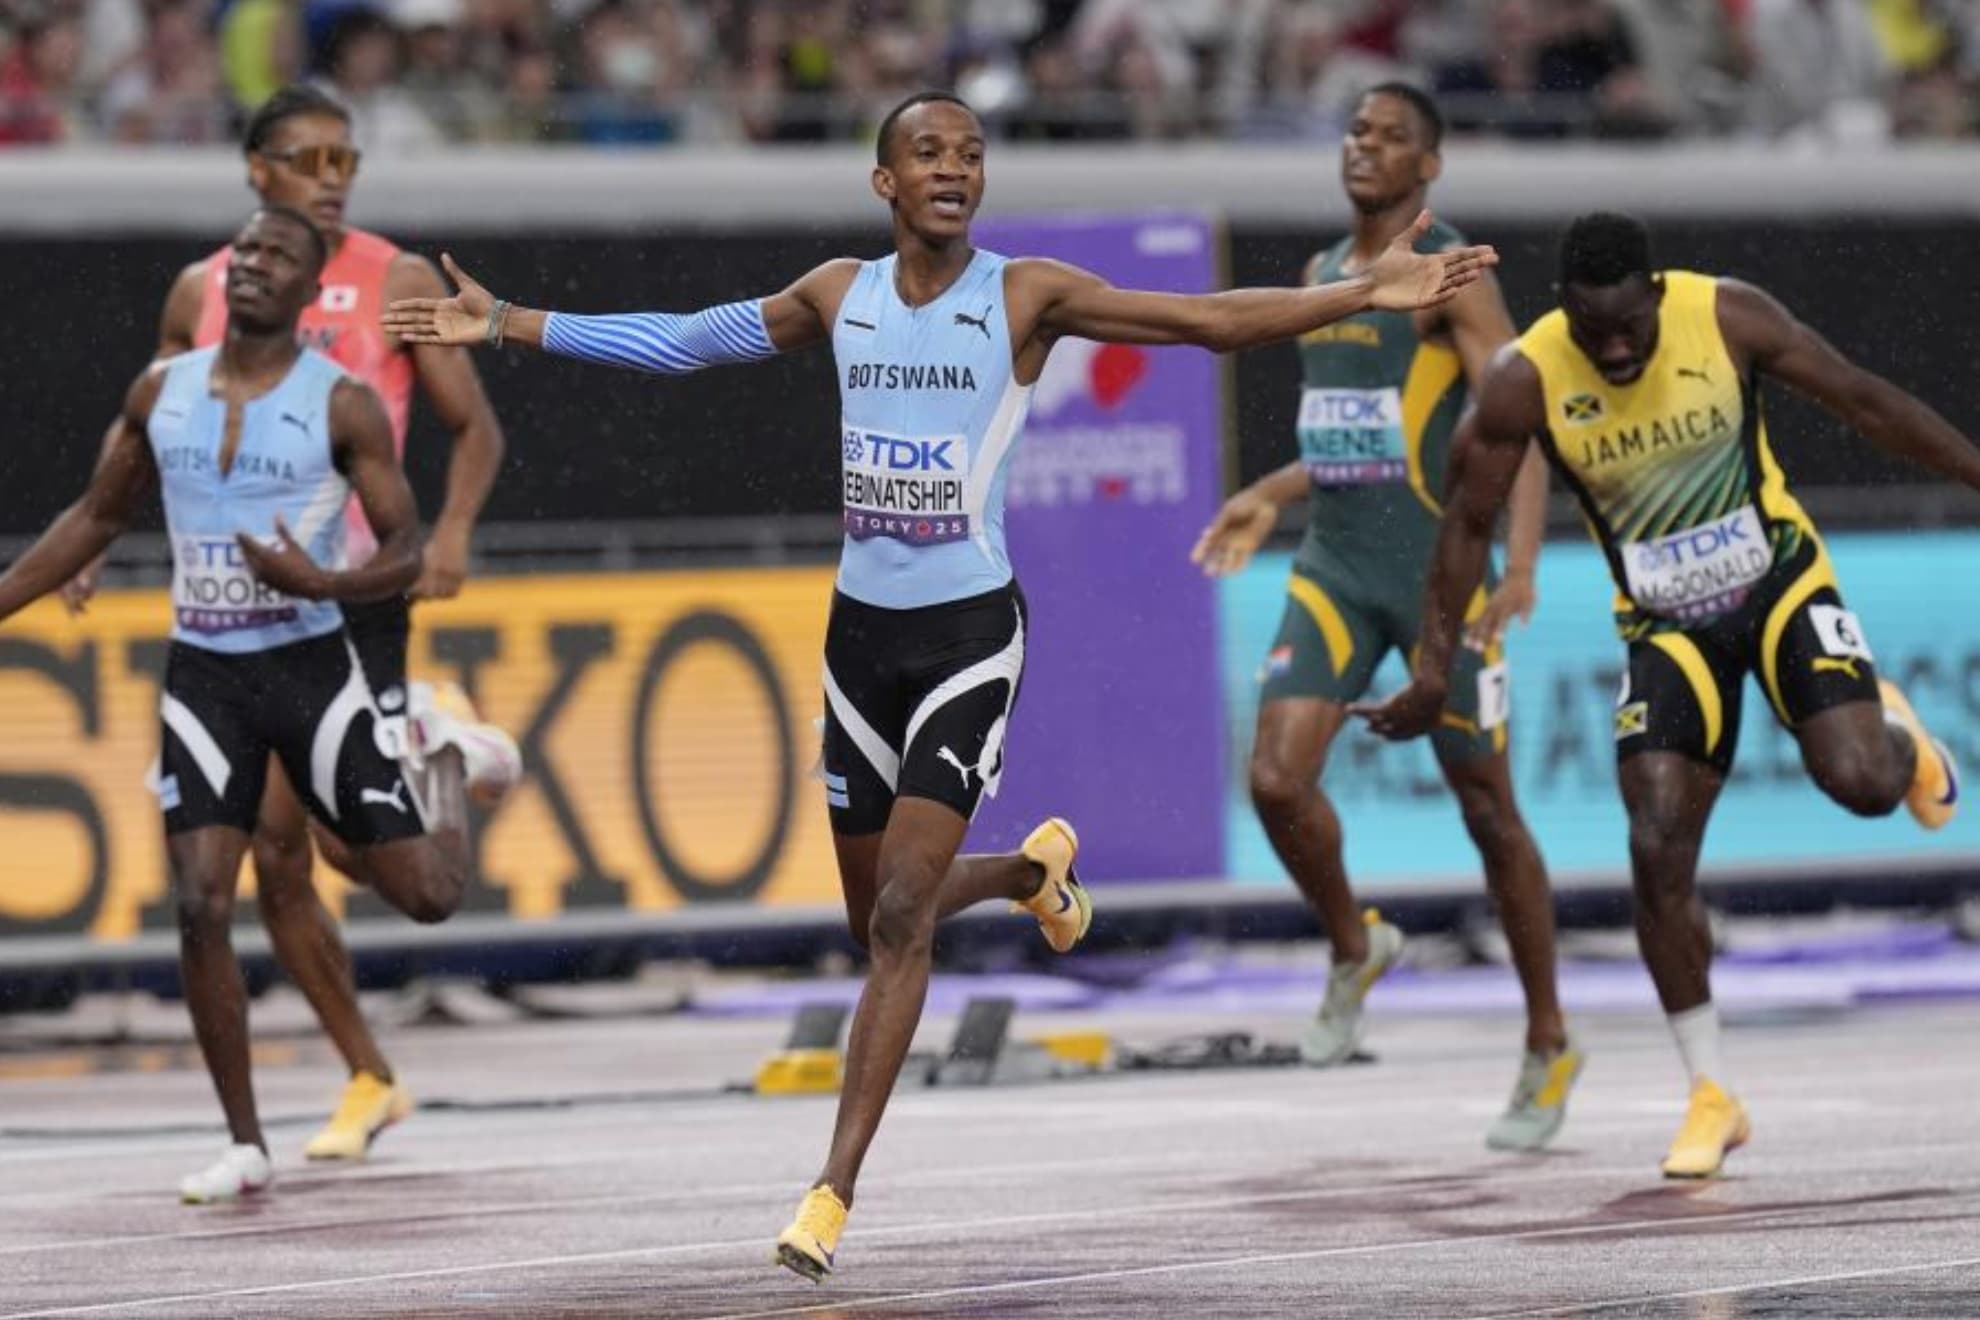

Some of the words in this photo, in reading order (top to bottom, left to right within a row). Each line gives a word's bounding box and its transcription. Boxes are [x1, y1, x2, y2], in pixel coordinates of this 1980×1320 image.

[848, 364, 976, 391] BOTSWANA
[1323, 394, 1387, 422] TDK
[865, 433, 954, 471] TDK
[1307, 429, 1386, 455] NENE
[1581, 405, 1728, 469] JAMAICA
[845, 470, 962, 511] EBINATSHIPI
[1663, 515, 1748, 564] TDK
[184, 576, 282, 606] NDOR
[1639, 546, 1767, 604] McDONALD
[1834, 617, 1858, 648] 6
[0, 608, 794, 935] SKO
